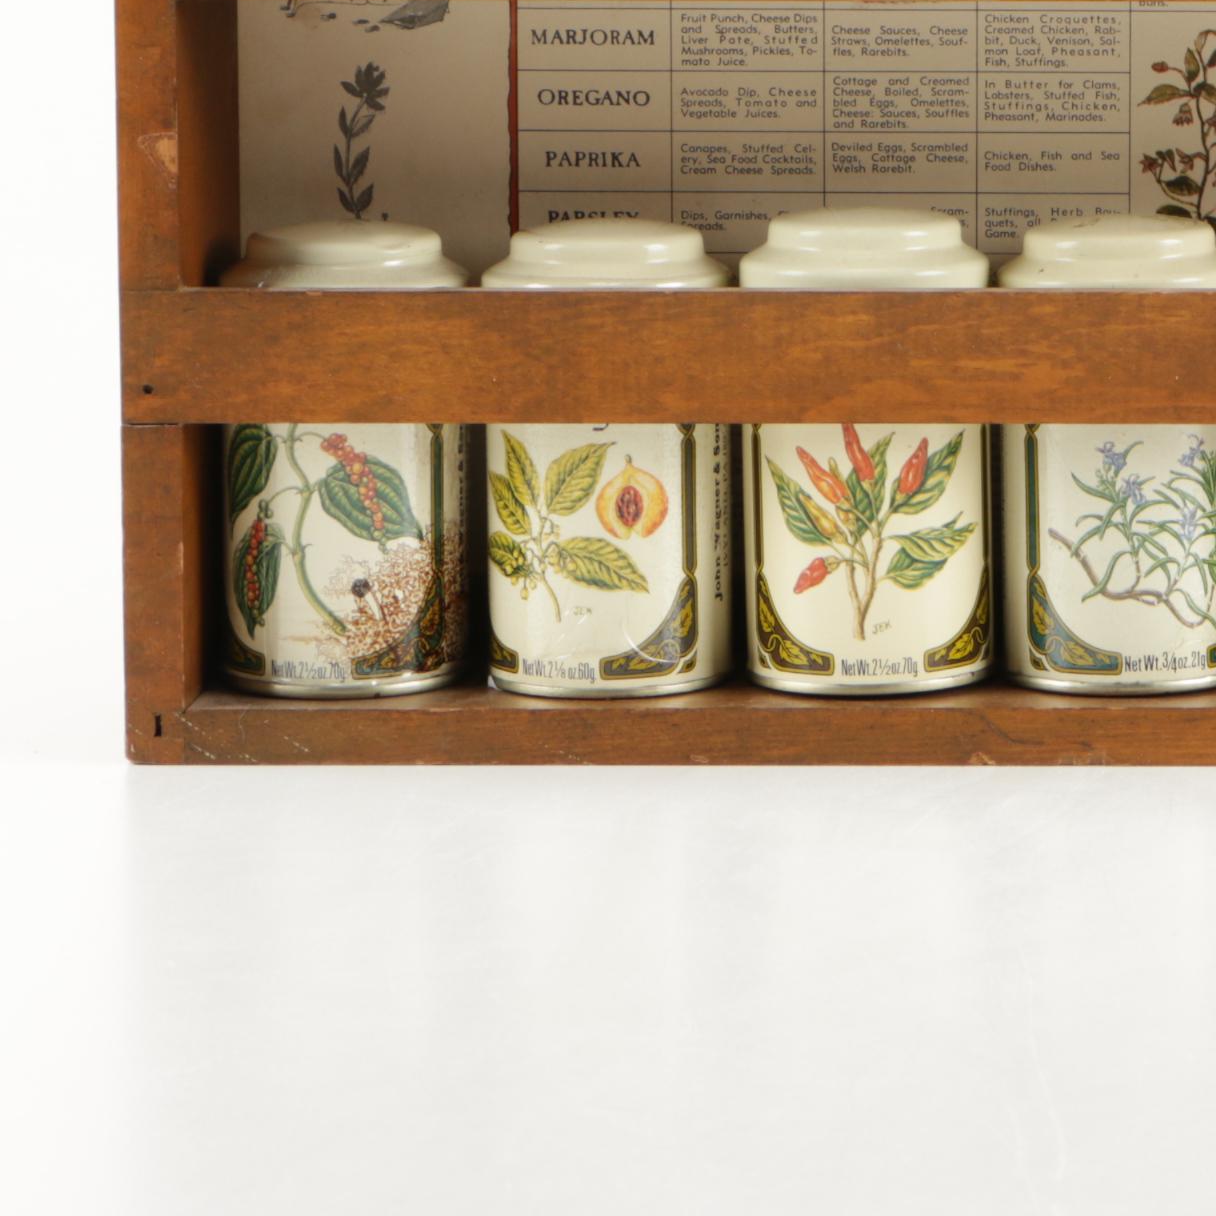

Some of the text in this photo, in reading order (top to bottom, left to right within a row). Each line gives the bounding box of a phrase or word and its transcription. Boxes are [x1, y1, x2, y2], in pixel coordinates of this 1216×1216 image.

[531, 28, 655, 46] MARJORAM
[537, 89, 650, 106] OREGANO
[680, 86, 817, 98] Avocado Dip, Cheese
[680, 97, 817, 109] Spreads, Tomato and
[680, 108, 783, 120] Vegetable Juices.
[545, 151, 641, 168] PAPRIKA
[984, 150, 1120, 162] Chicken, Fish and Sea
[984, 161, 1057, 172] Food Dishes.
